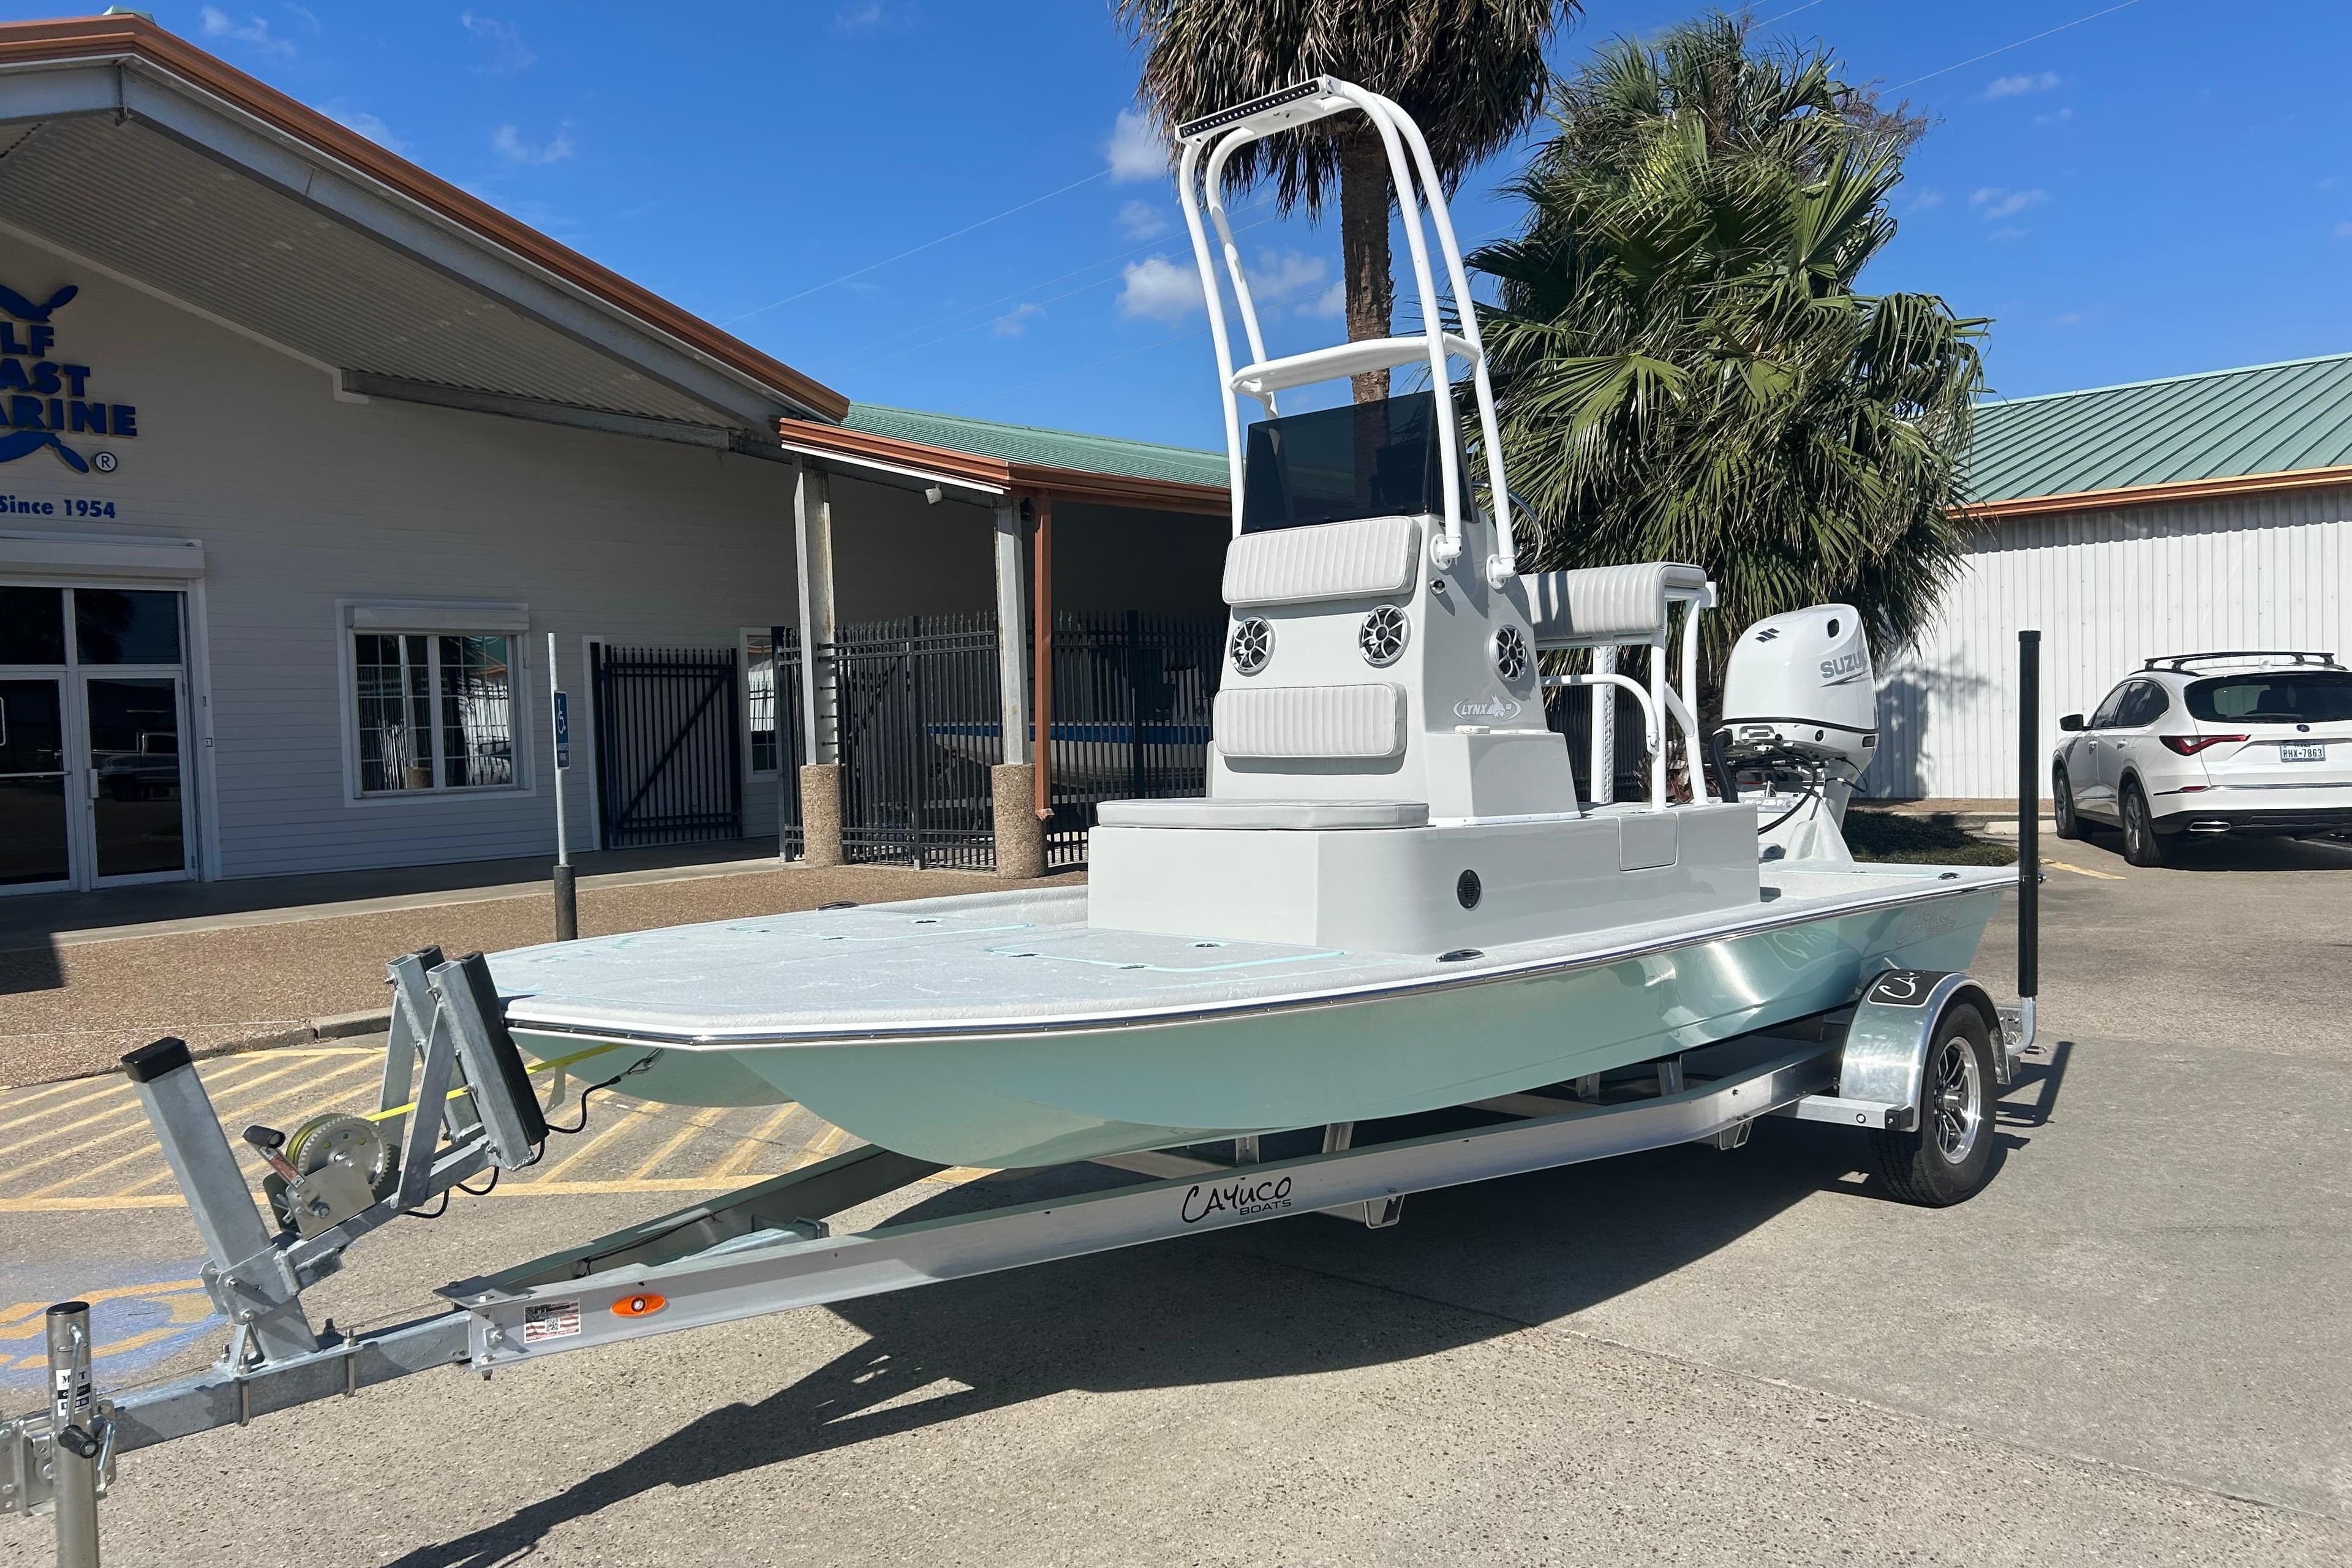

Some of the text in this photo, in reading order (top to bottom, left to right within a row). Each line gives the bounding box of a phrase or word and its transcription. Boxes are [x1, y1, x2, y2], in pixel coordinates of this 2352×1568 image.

[0, 495, 115, 519] Since 1954
[1461, 704, 1488, 715] LYNX
[1240, 1199, 1292, 1216] BOATS
